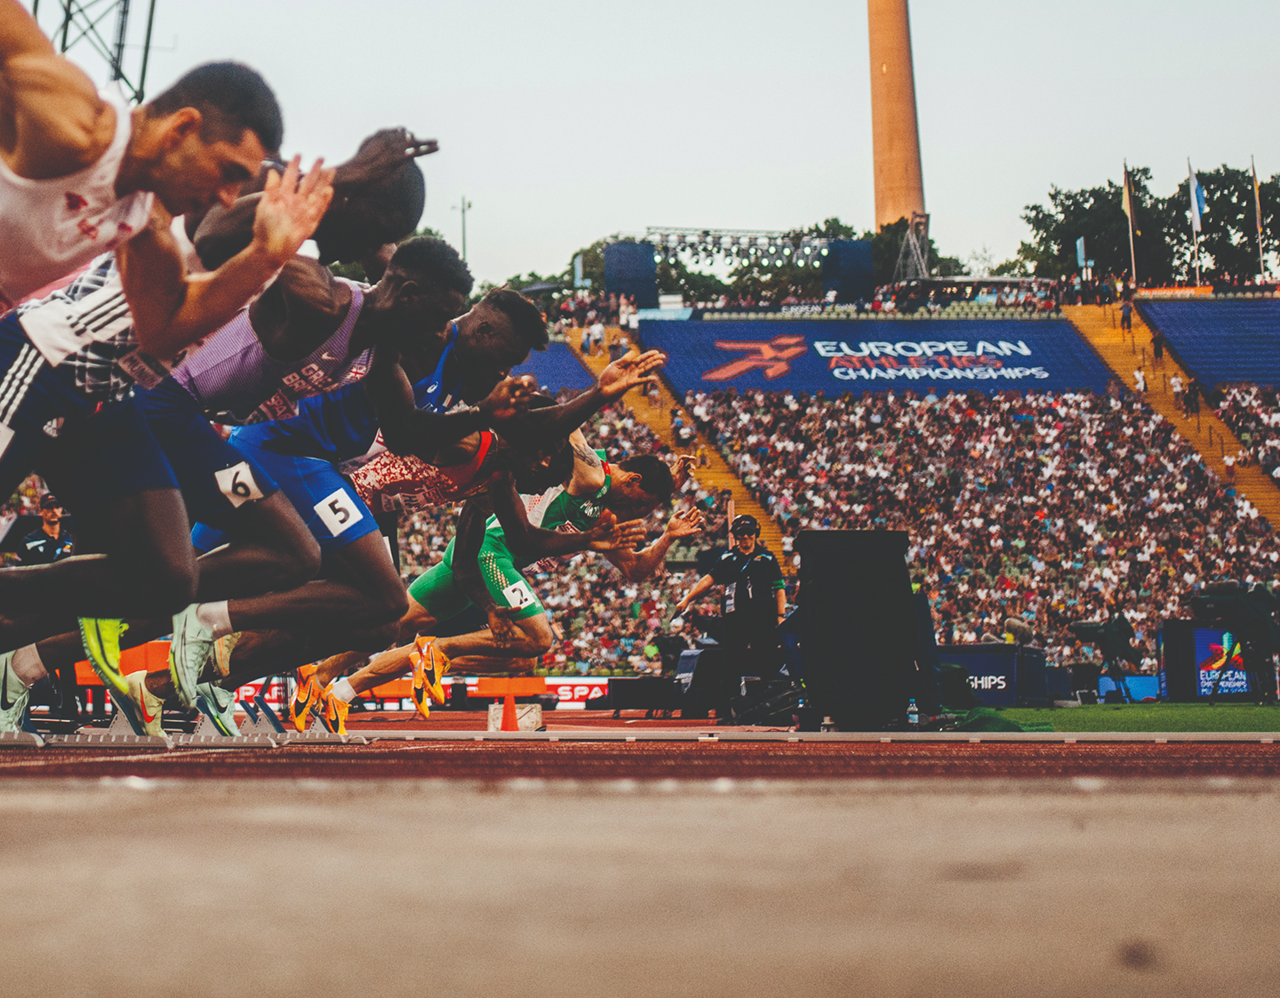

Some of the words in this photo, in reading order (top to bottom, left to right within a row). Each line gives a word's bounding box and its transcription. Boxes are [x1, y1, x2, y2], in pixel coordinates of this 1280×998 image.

[813, 340, 1032, 357] EUROPEAN
[829, 355, 1003, 369] ATHLETICS
[833, 366, 1049, 380] CHAMPIONSHIPS
[231, 471, 251, 497] 6
[328, 498, 350, 524] 5
[511, 587, 529, 605] 2
